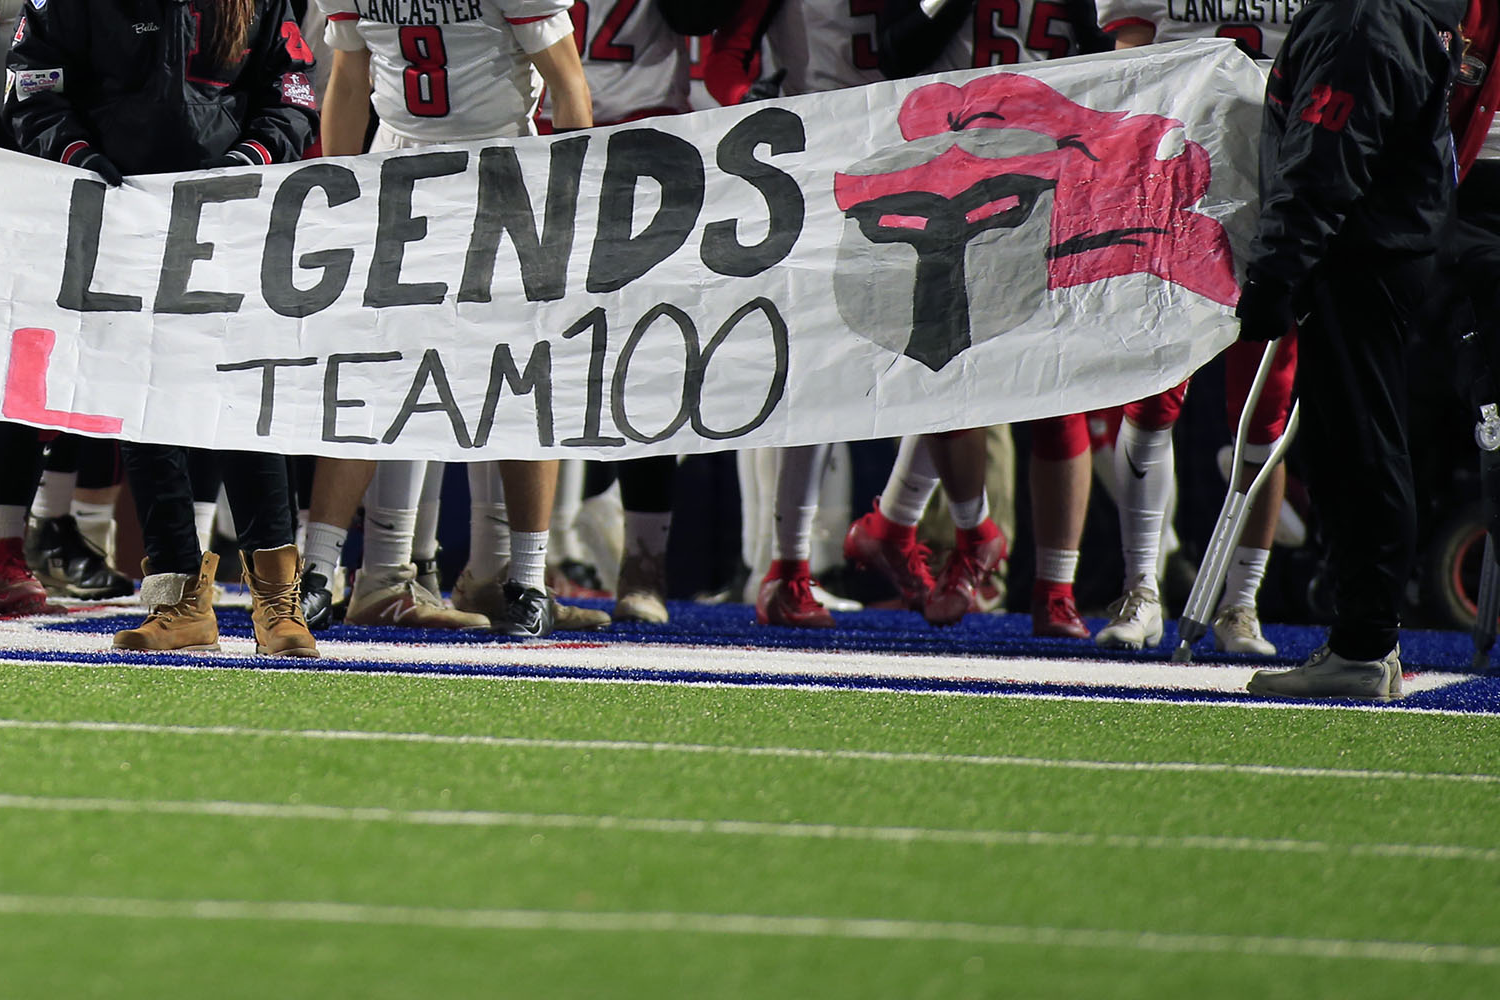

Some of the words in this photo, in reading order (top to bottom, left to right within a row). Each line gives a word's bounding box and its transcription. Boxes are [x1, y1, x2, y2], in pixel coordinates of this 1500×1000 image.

[399, 25, 450, 117] 8
[1301, 84, 1355, 132] 20
[56, 107, 806, 318] LEGENDS
